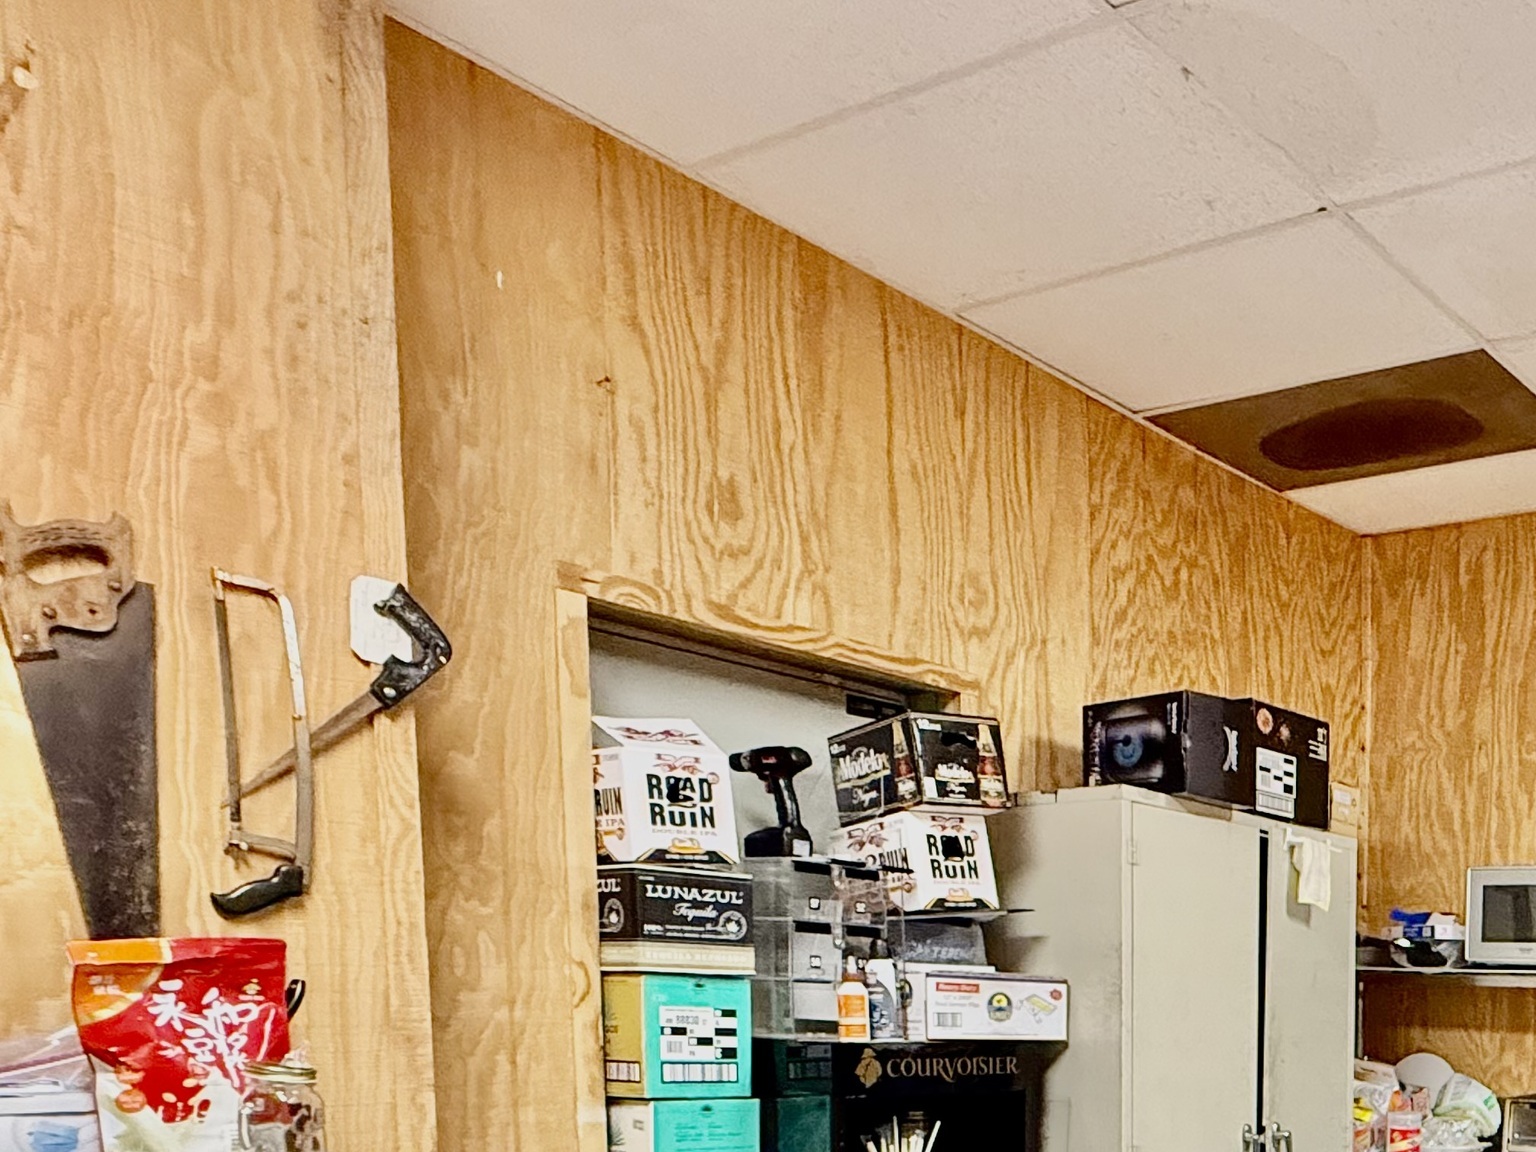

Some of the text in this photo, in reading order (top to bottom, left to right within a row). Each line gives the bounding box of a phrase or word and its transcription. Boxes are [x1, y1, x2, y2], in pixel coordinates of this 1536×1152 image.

[649, 802, 716, 829] RUIN
[926, 834, 976, 857] RD
[930, 859, 980, 880] RUIN
[645, 884, 744, 905] LUNAZUL
[673, 902, 719, 922] Tequila
[886, 1055, 1020, 1083] COURVOISIER
